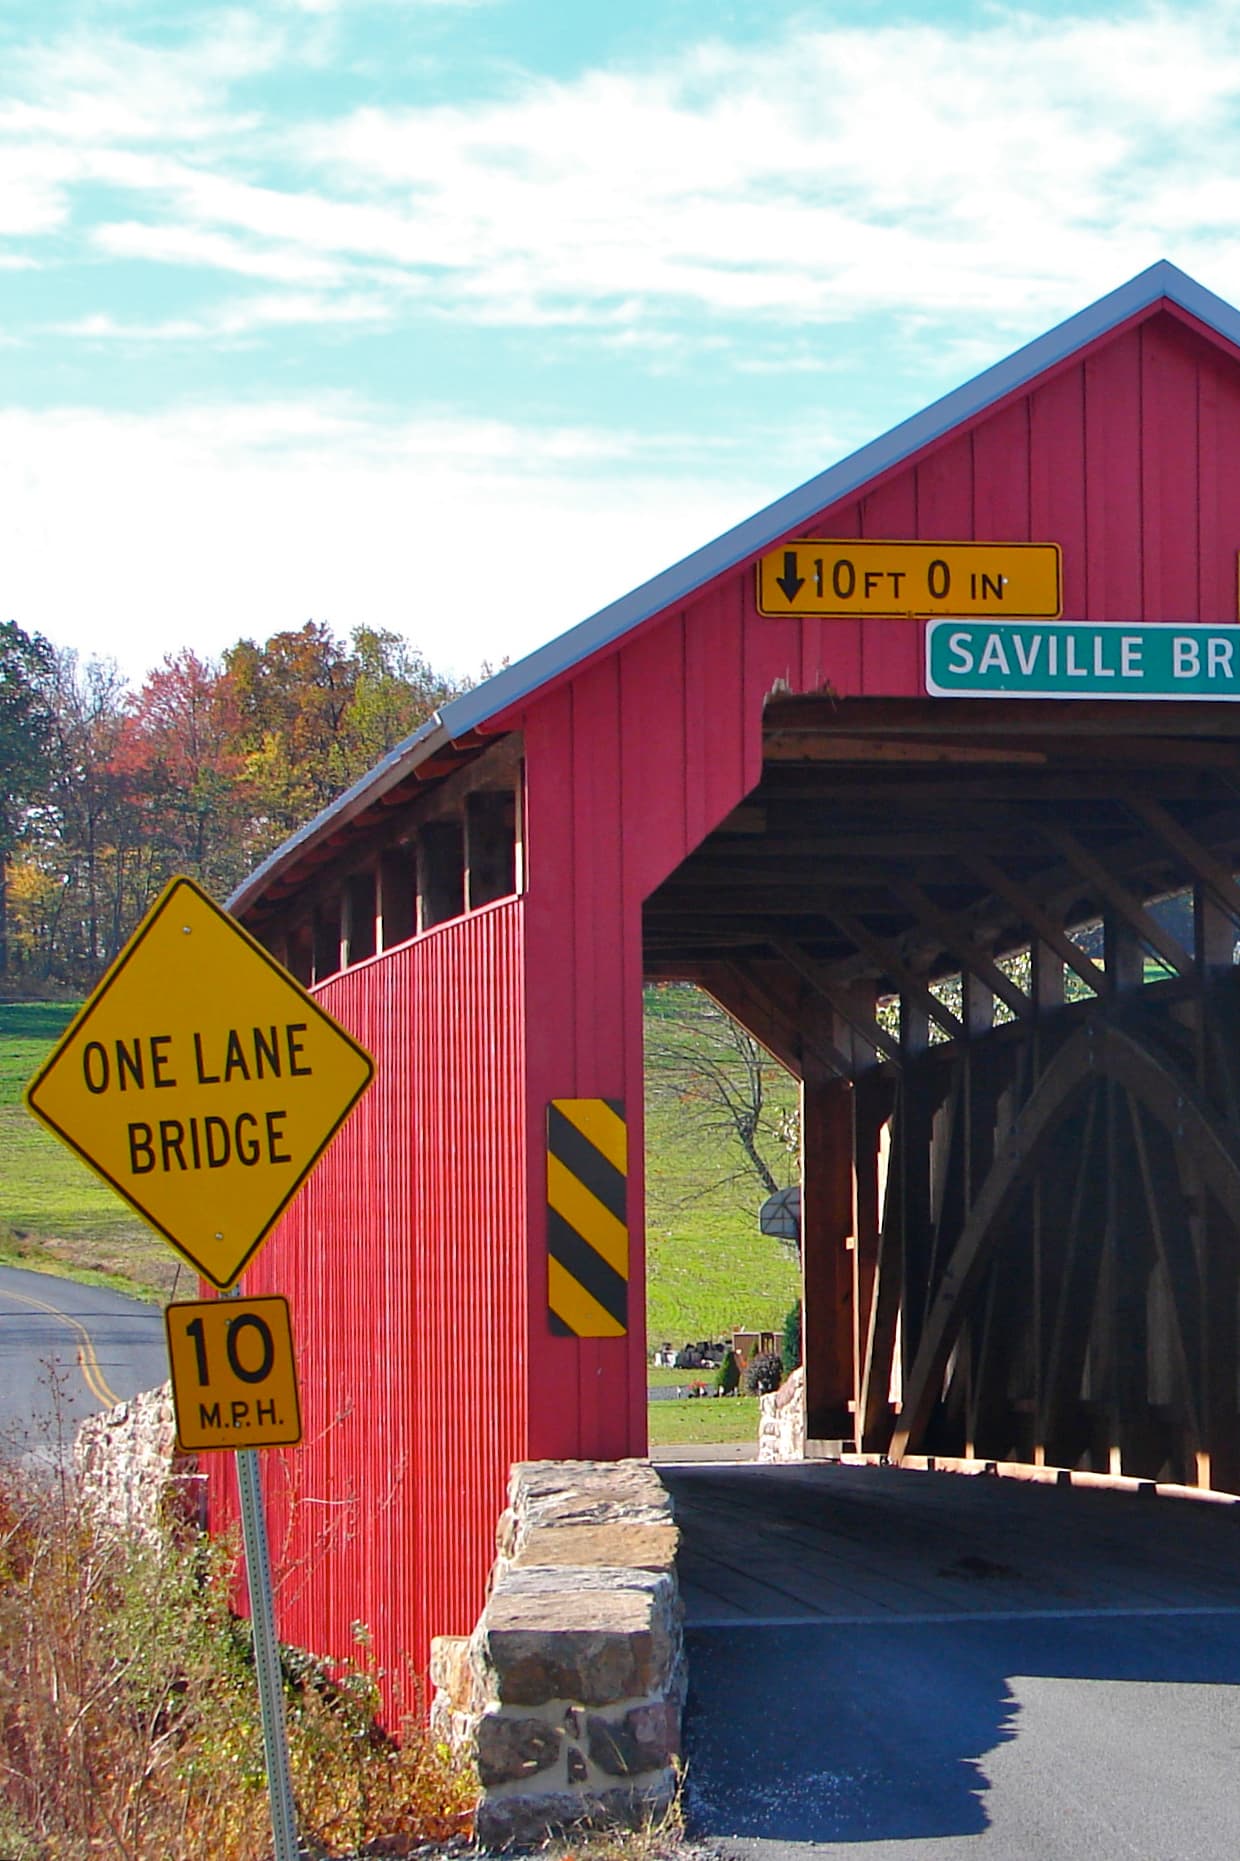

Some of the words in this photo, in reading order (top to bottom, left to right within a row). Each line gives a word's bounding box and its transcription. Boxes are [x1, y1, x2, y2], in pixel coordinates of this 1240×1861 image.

[927, 560, 951, 600] 0
[970, 573, 1005, 602] IN
[947, 632, 1145, 678] SAVILLE
[82, 1035, 177, 1094] ONE
[193, 1023, 313, 1084] LANE
[127, 1110, 293, 1174] BRIDGE
[186, 1312, 275, 1387] 10
[199, 1398, 285, 1430] M.P.H.
